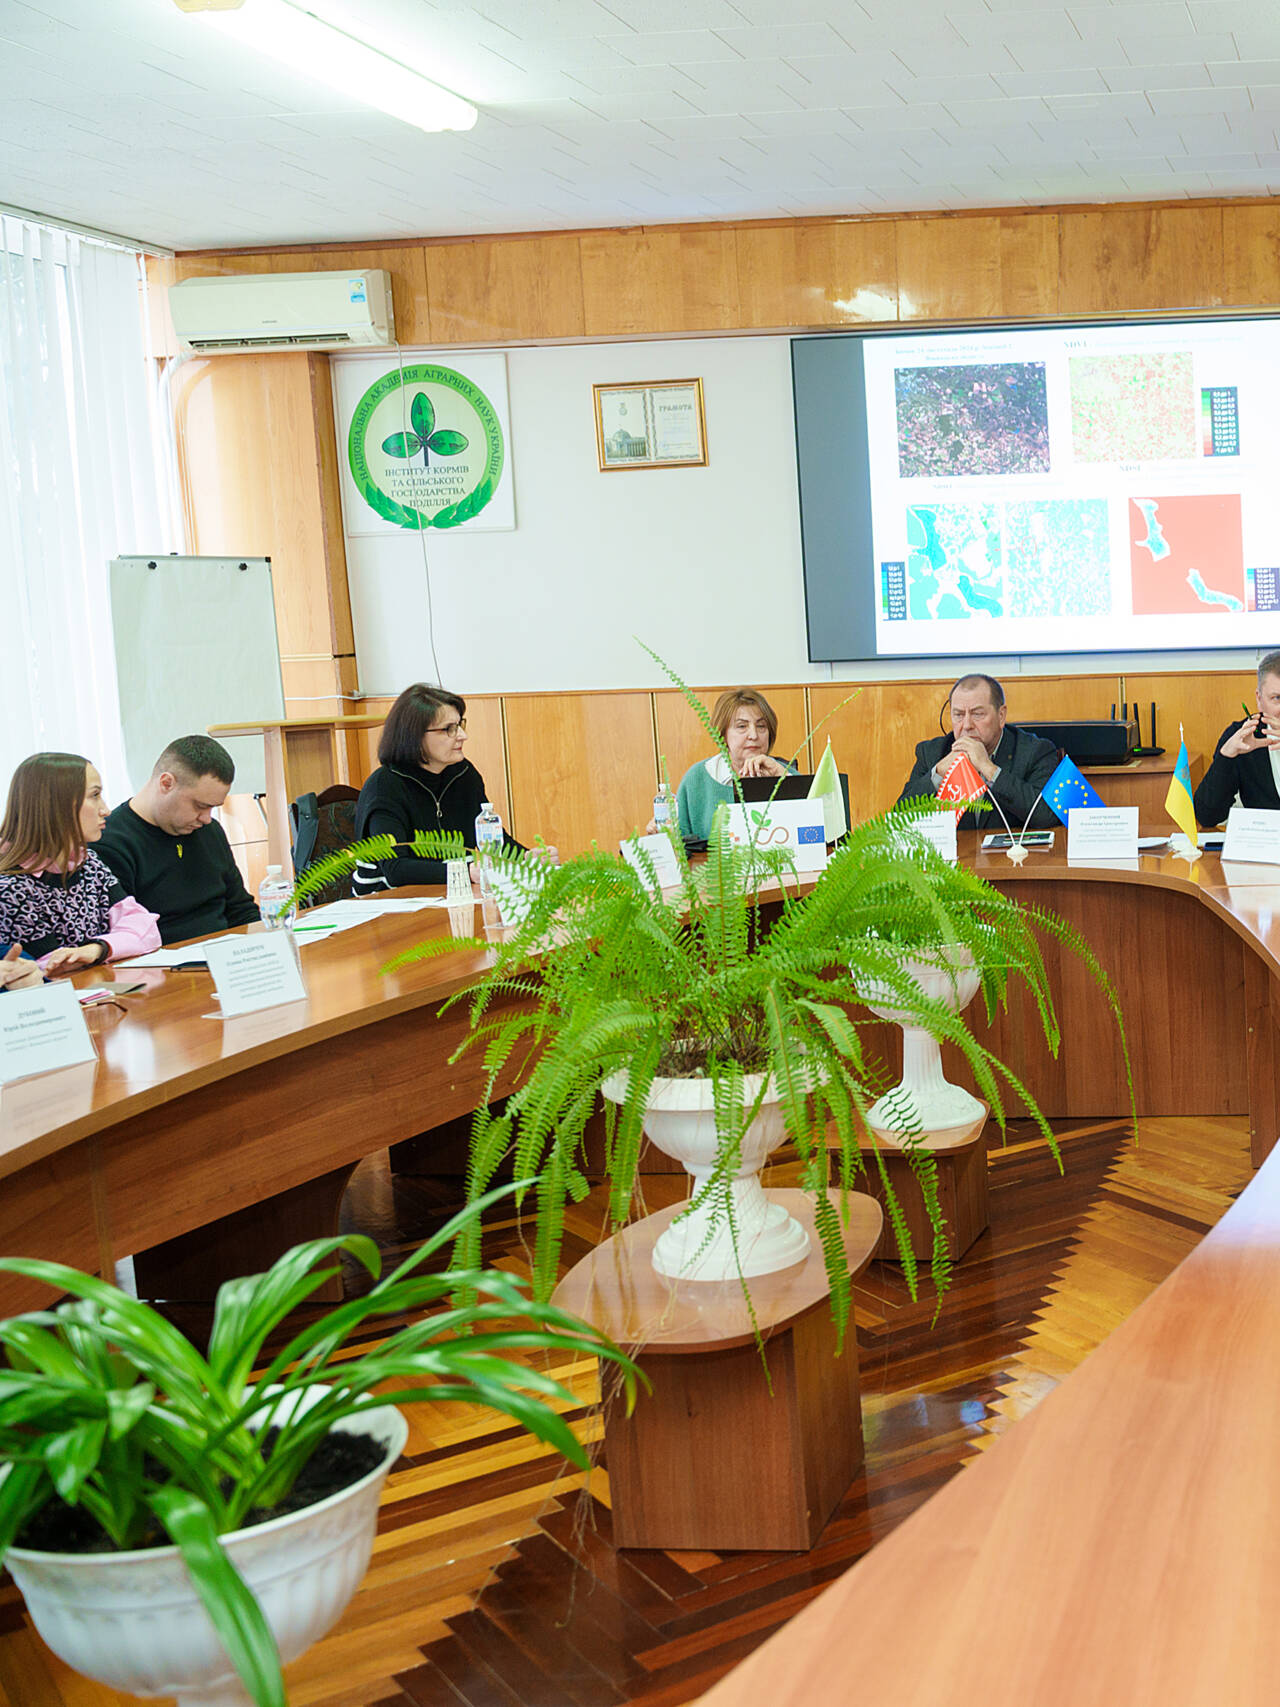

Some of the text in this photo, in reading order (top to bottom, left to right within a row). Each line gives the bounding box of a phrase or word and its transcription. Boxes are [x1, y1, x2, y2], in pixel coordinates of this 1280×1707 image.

[352, 369, 501, 480] НАЦІОНАЛЬНА АКАДЕМІЯ АГРАРНИХ НАУК УКРАЇНИ
[385, 465, 469, 477] ІНСТИТУТ КОРМІВ
[392, 476, 464, 487] ТА СІЛЬСЬКОГО
[390, 487, 466, 498] ГОСПОДАРСТВА
[409, 498, 451, 508] ПОДІЛЛЯ
